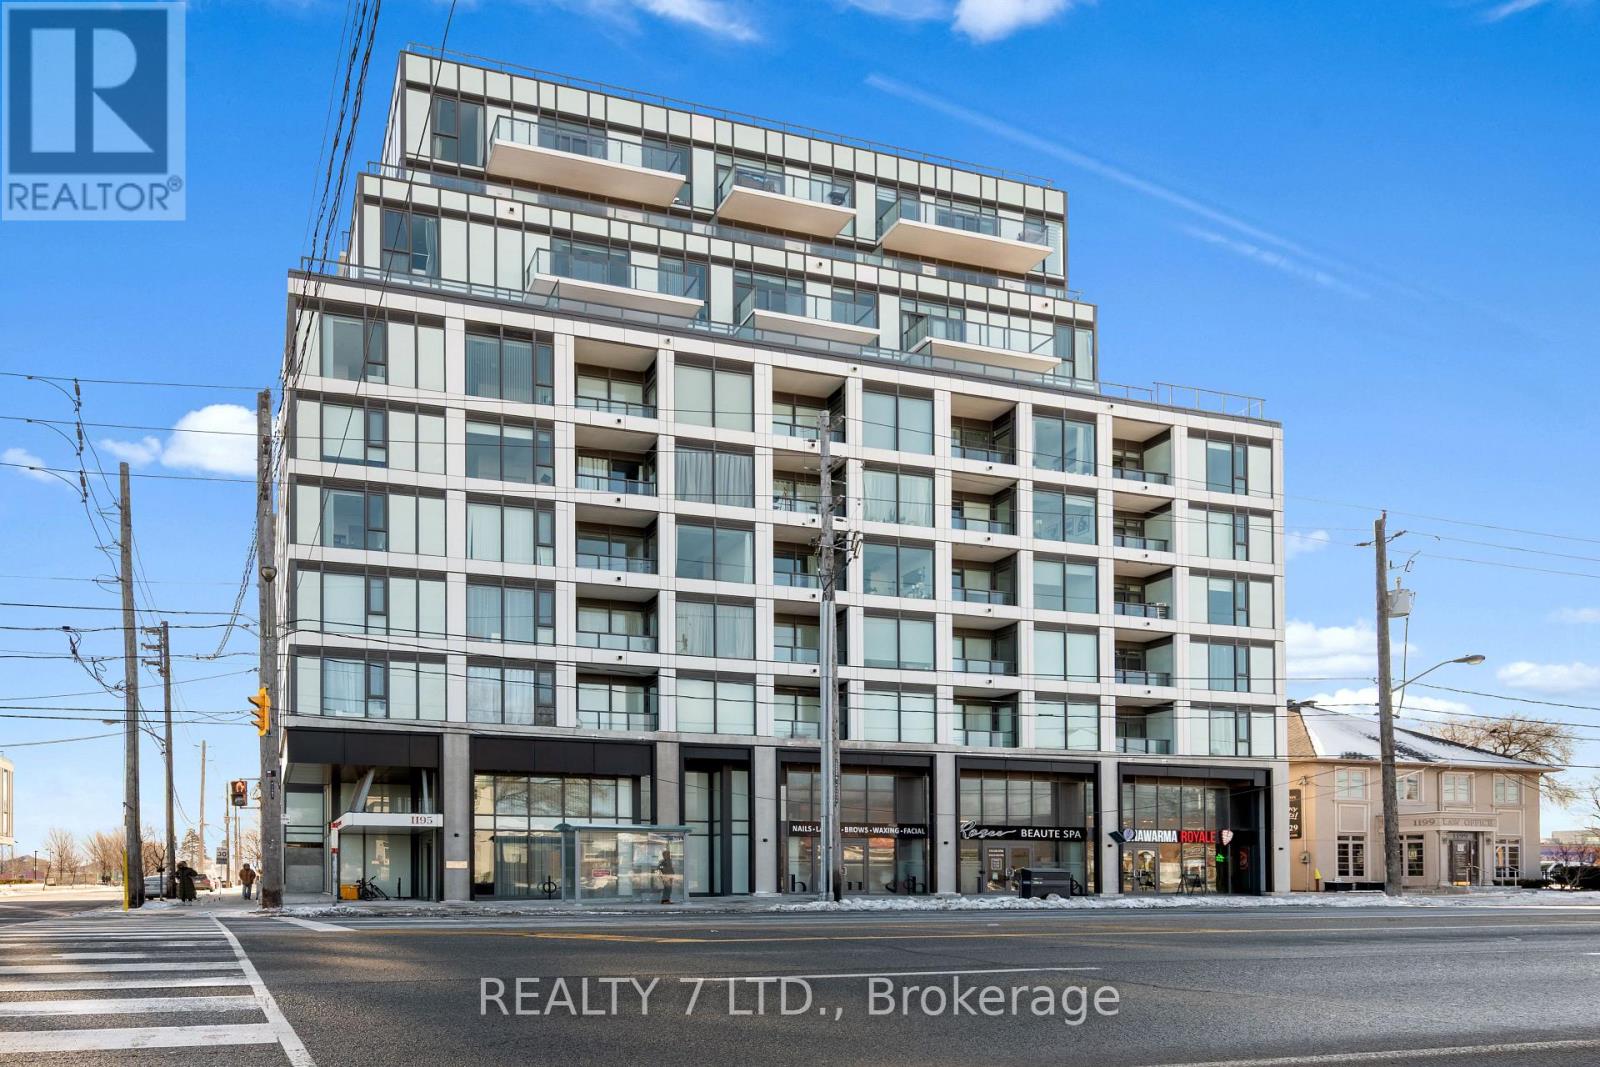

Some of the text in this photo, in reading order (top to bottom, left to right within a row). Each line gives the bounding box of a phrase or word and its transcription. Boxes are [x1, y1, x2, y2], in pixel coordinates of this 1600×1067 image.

[411, 815, 433, 825] 1195
[1413, 818, 1436, 827] 1199
[792, 825, 812, 833] NAILS
[844, 826, 869, 834] BROWS
[872, 827, 900, 835] WAXING
[903, 827, 926, 835] FACIAL
[1021, 828, 1060, 839] BEAUTE
[1063, 829, 1082, 839] SPA
[1180, 831, 1217, 843] ROYALE
